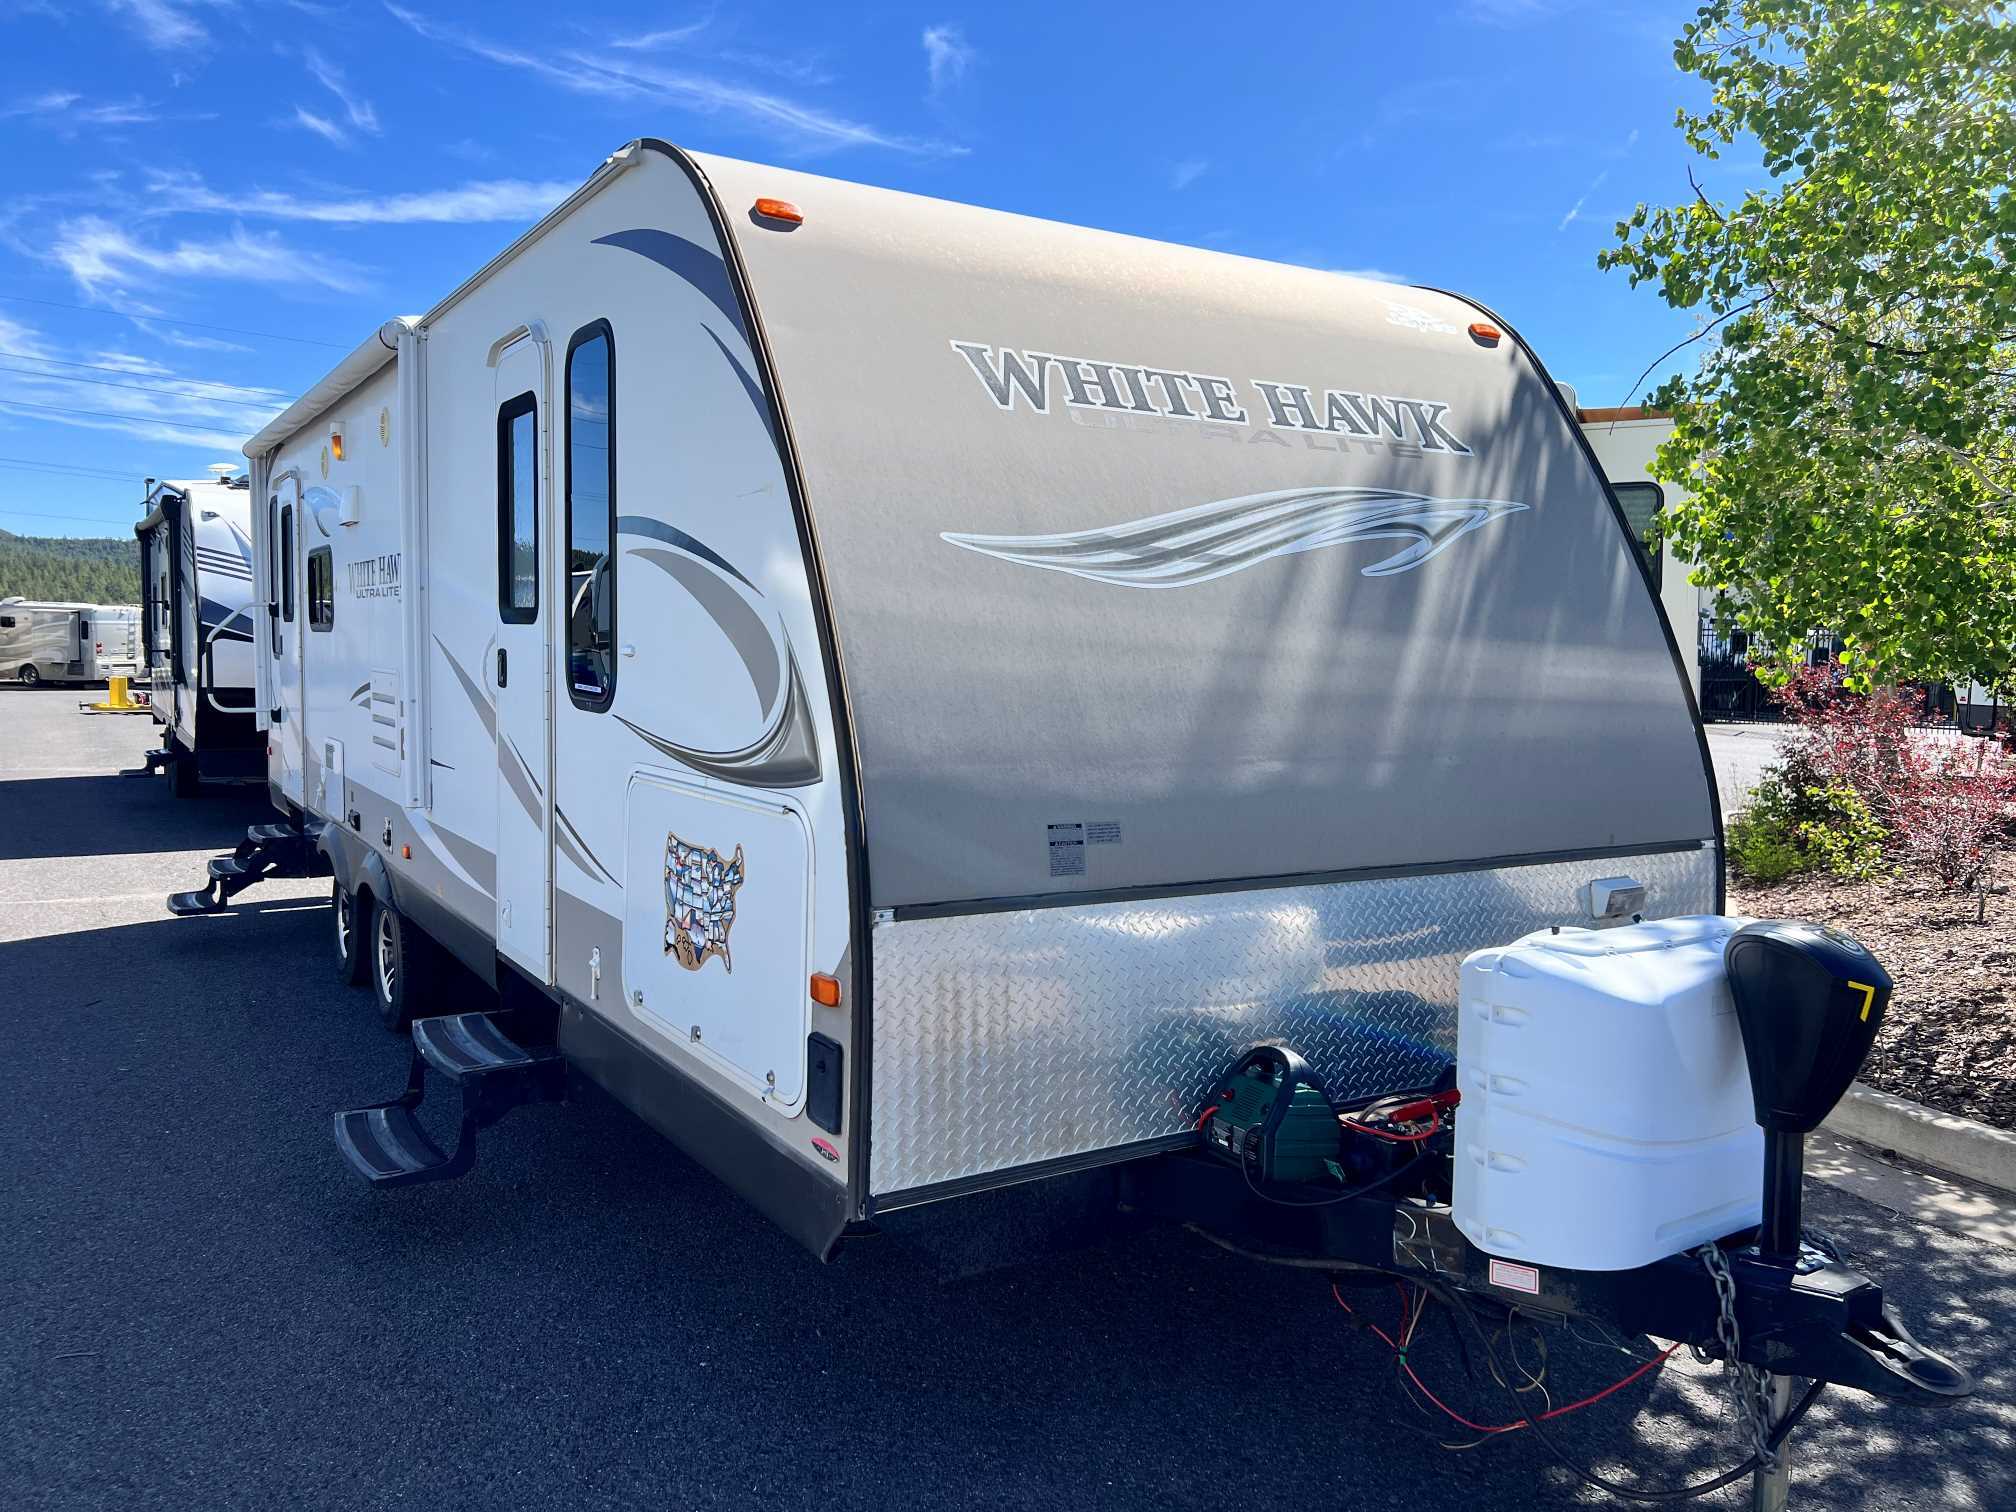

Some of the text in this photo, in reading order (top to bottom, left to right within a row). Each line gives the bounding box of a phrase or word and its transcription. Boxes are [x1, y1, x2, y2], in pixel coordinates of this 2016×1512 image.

[949, 339, 1475, 457] WHITE HAWK
[1302, 434, 1423, 459] LITE
[347, 552, 402, 595] WHITE HAW
[355, 585, 400, 600] ULTRA LITE
